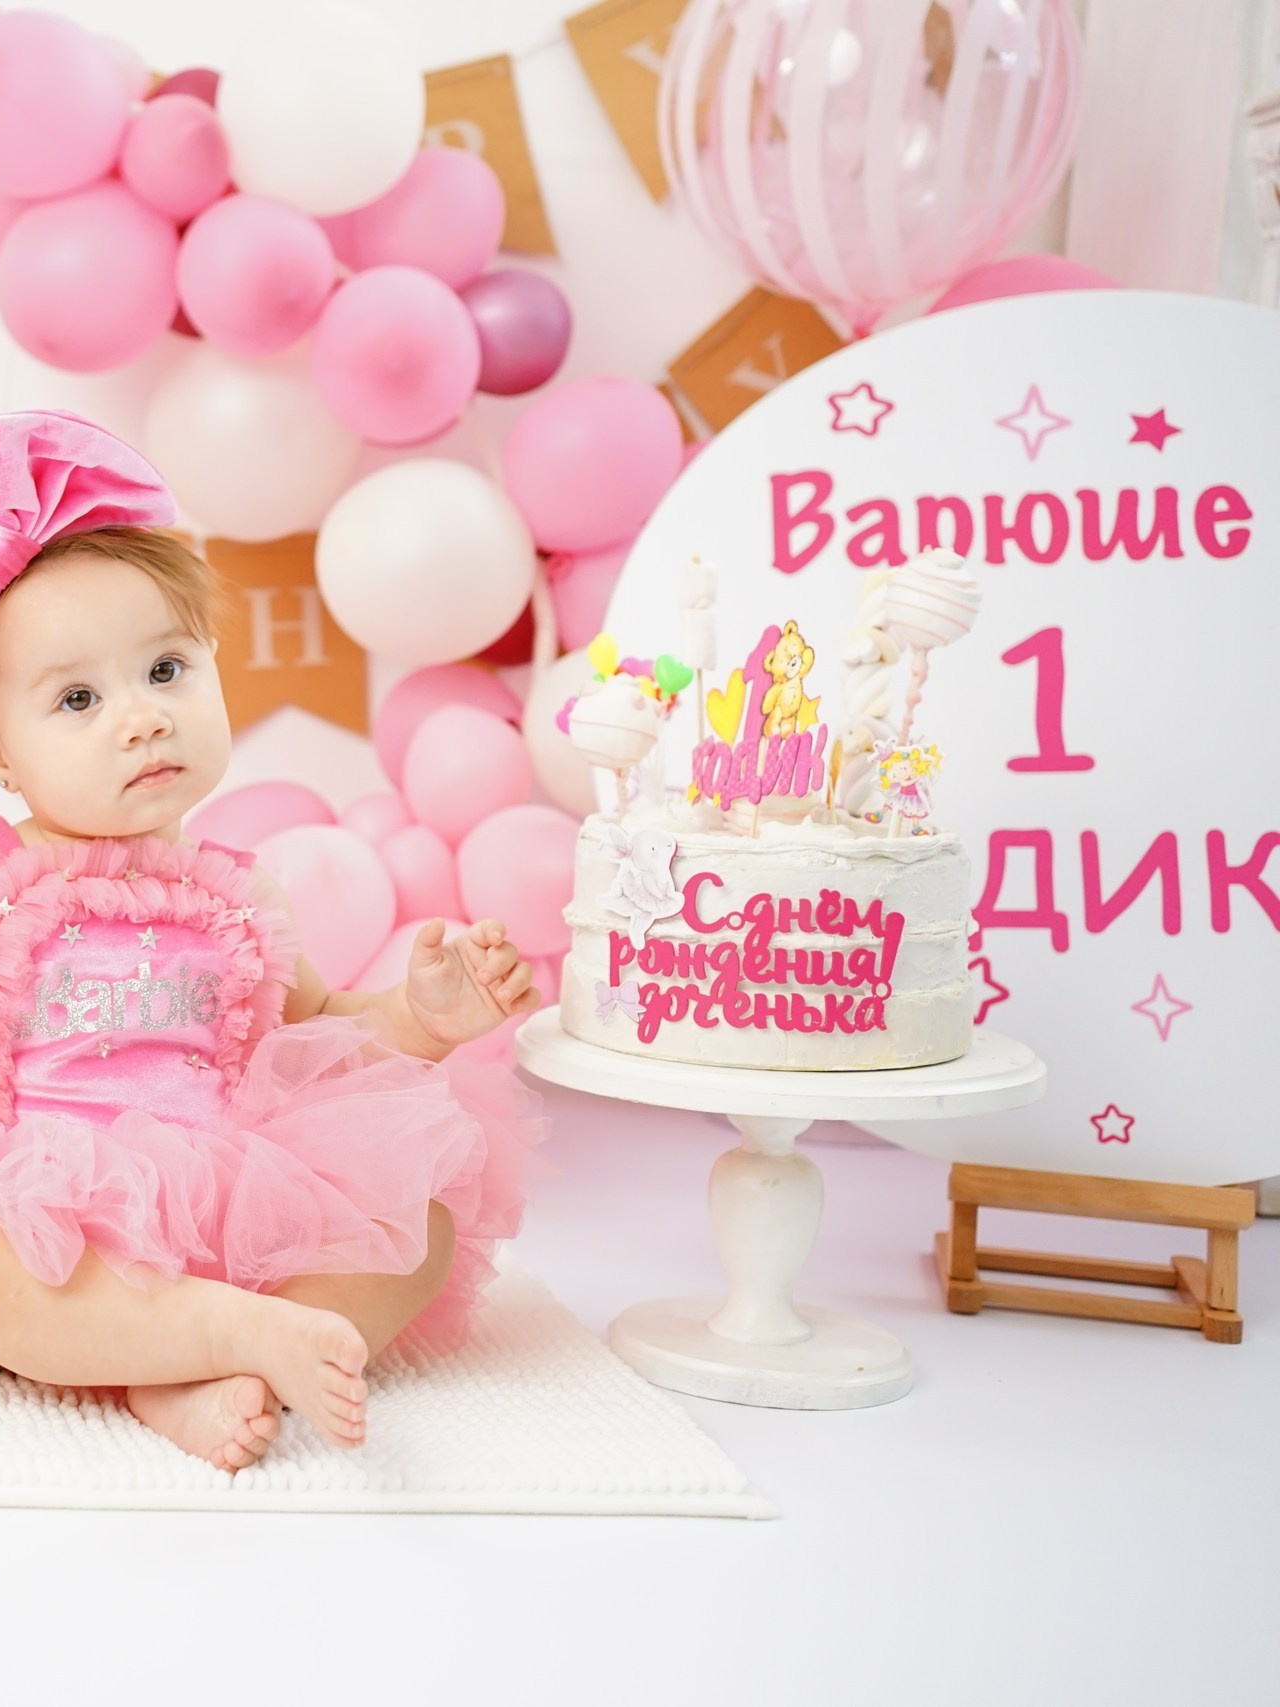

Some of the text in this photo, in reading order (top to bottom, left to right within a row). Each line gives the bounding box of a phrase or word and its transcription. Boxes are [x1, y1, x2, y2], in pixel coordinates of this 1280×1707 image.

[243, 586, 332, 671] H
[1001, 626, 1096, 773] 1
[682, 872, 724, 934] С
[968, 828, 1280, 954] ДИК
[10, 961, 222, 1040] Barbie
